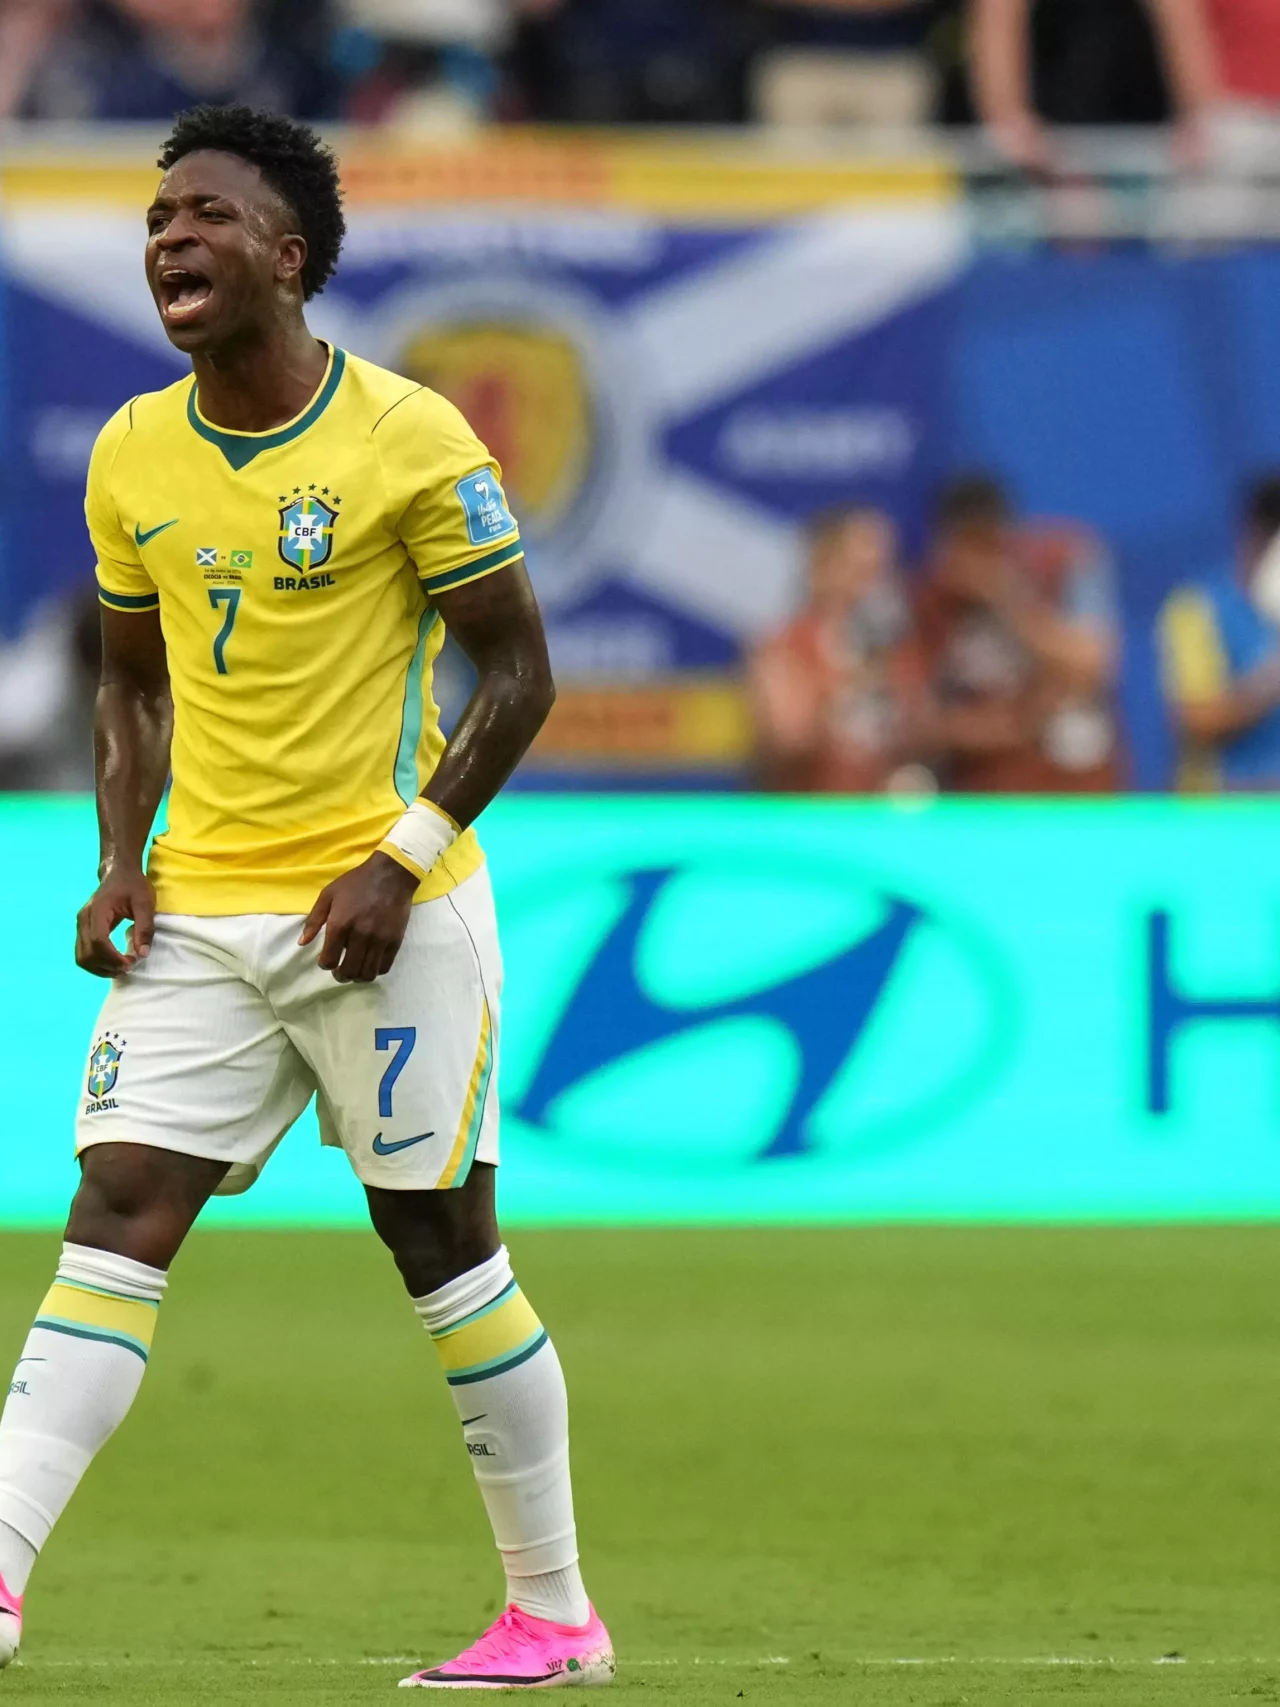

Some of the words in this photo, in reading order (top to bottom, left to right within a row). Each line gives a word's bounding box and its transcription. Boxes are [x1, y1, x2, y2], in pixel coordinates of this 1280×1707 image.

[294, 527, 317, 537] CBF
[273, 573, 336, 591] BRASIL
[207, 588, 242, 676] 7
[95, 1063, 109, 1073] CBF
[374, 1026, 417, 1118] 7
[85, 1098, 120, 1116] BRASIL
